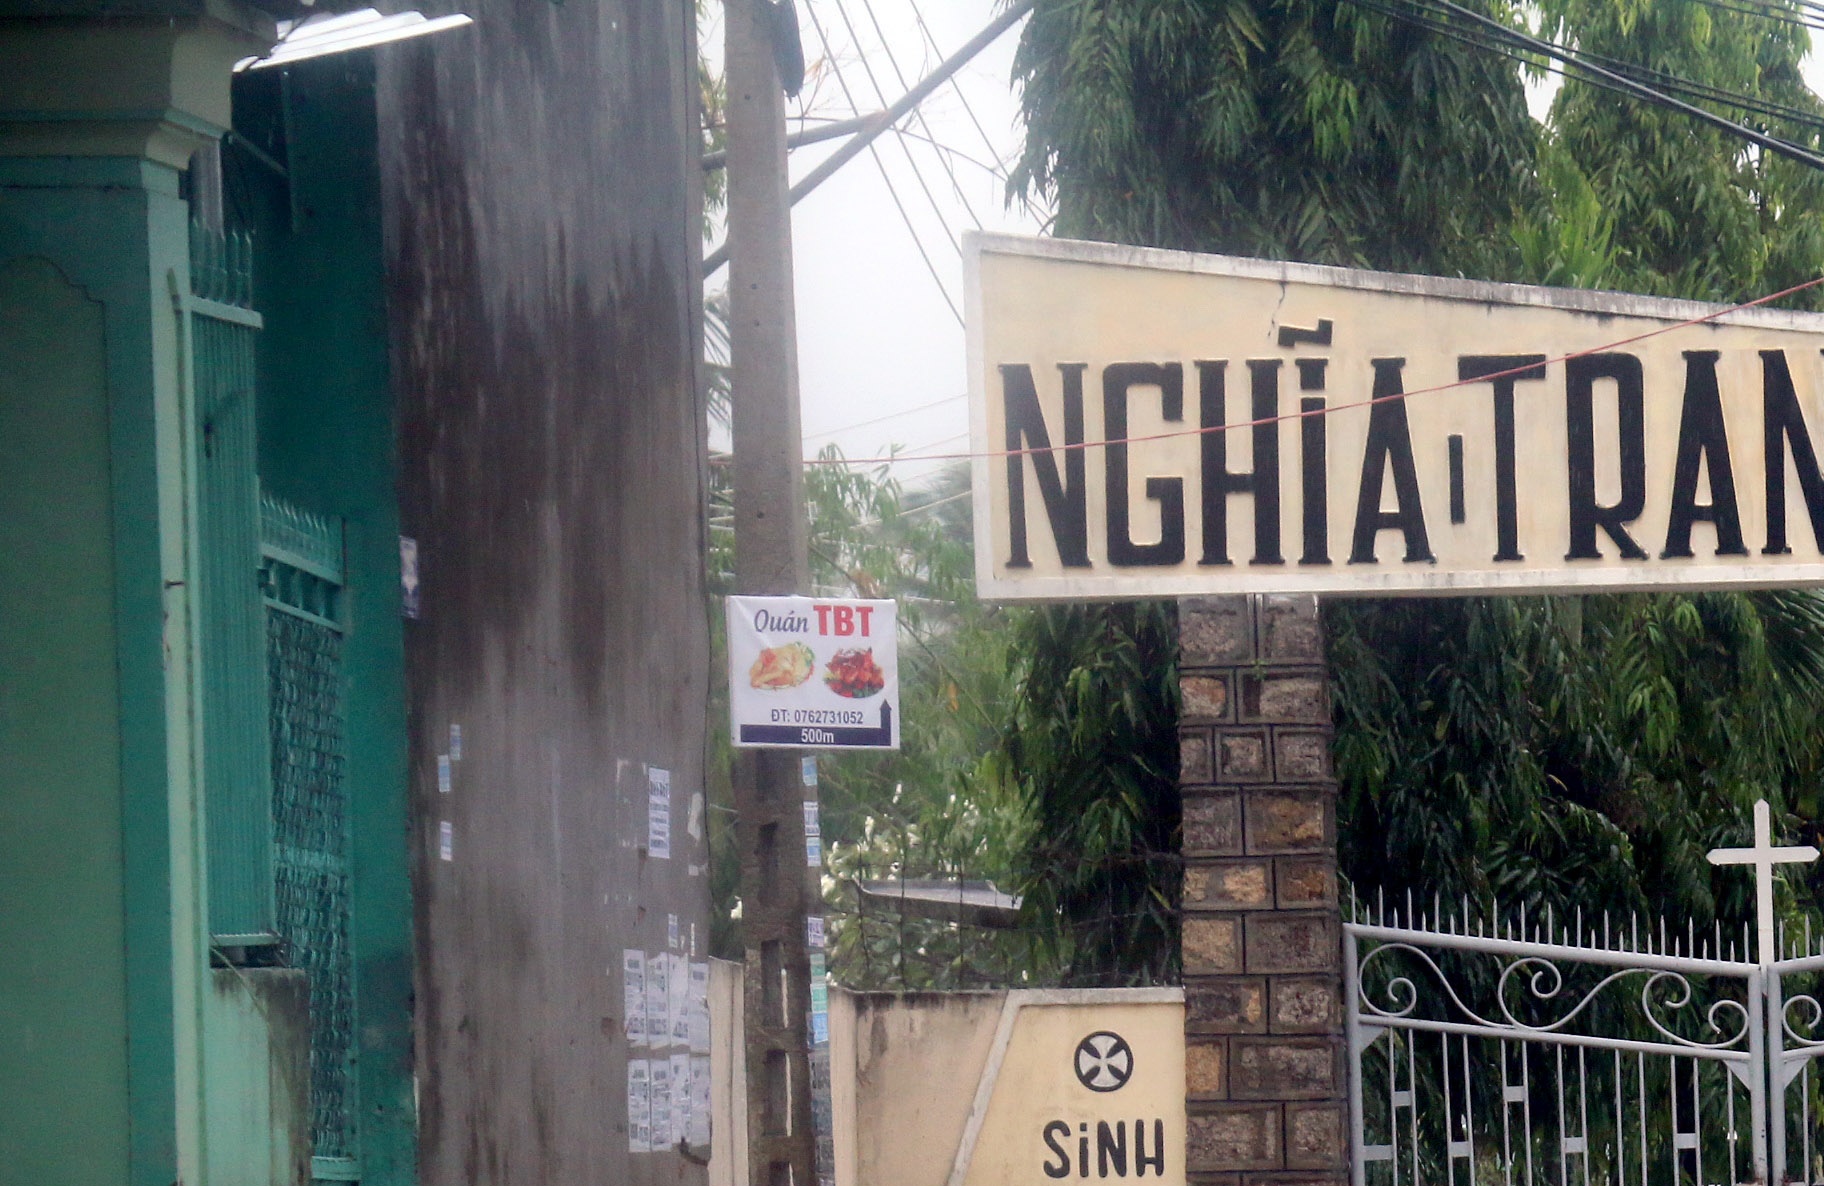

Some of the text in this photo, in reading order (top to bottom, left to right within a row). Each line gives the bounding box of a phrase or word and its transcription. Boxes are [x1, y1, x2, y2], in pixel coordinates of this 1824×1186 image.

[754, 604, 874, 637] Quán TBT
[794, 709, 864, 724] 0762731052
[801, 728, 835, 744] 500m
